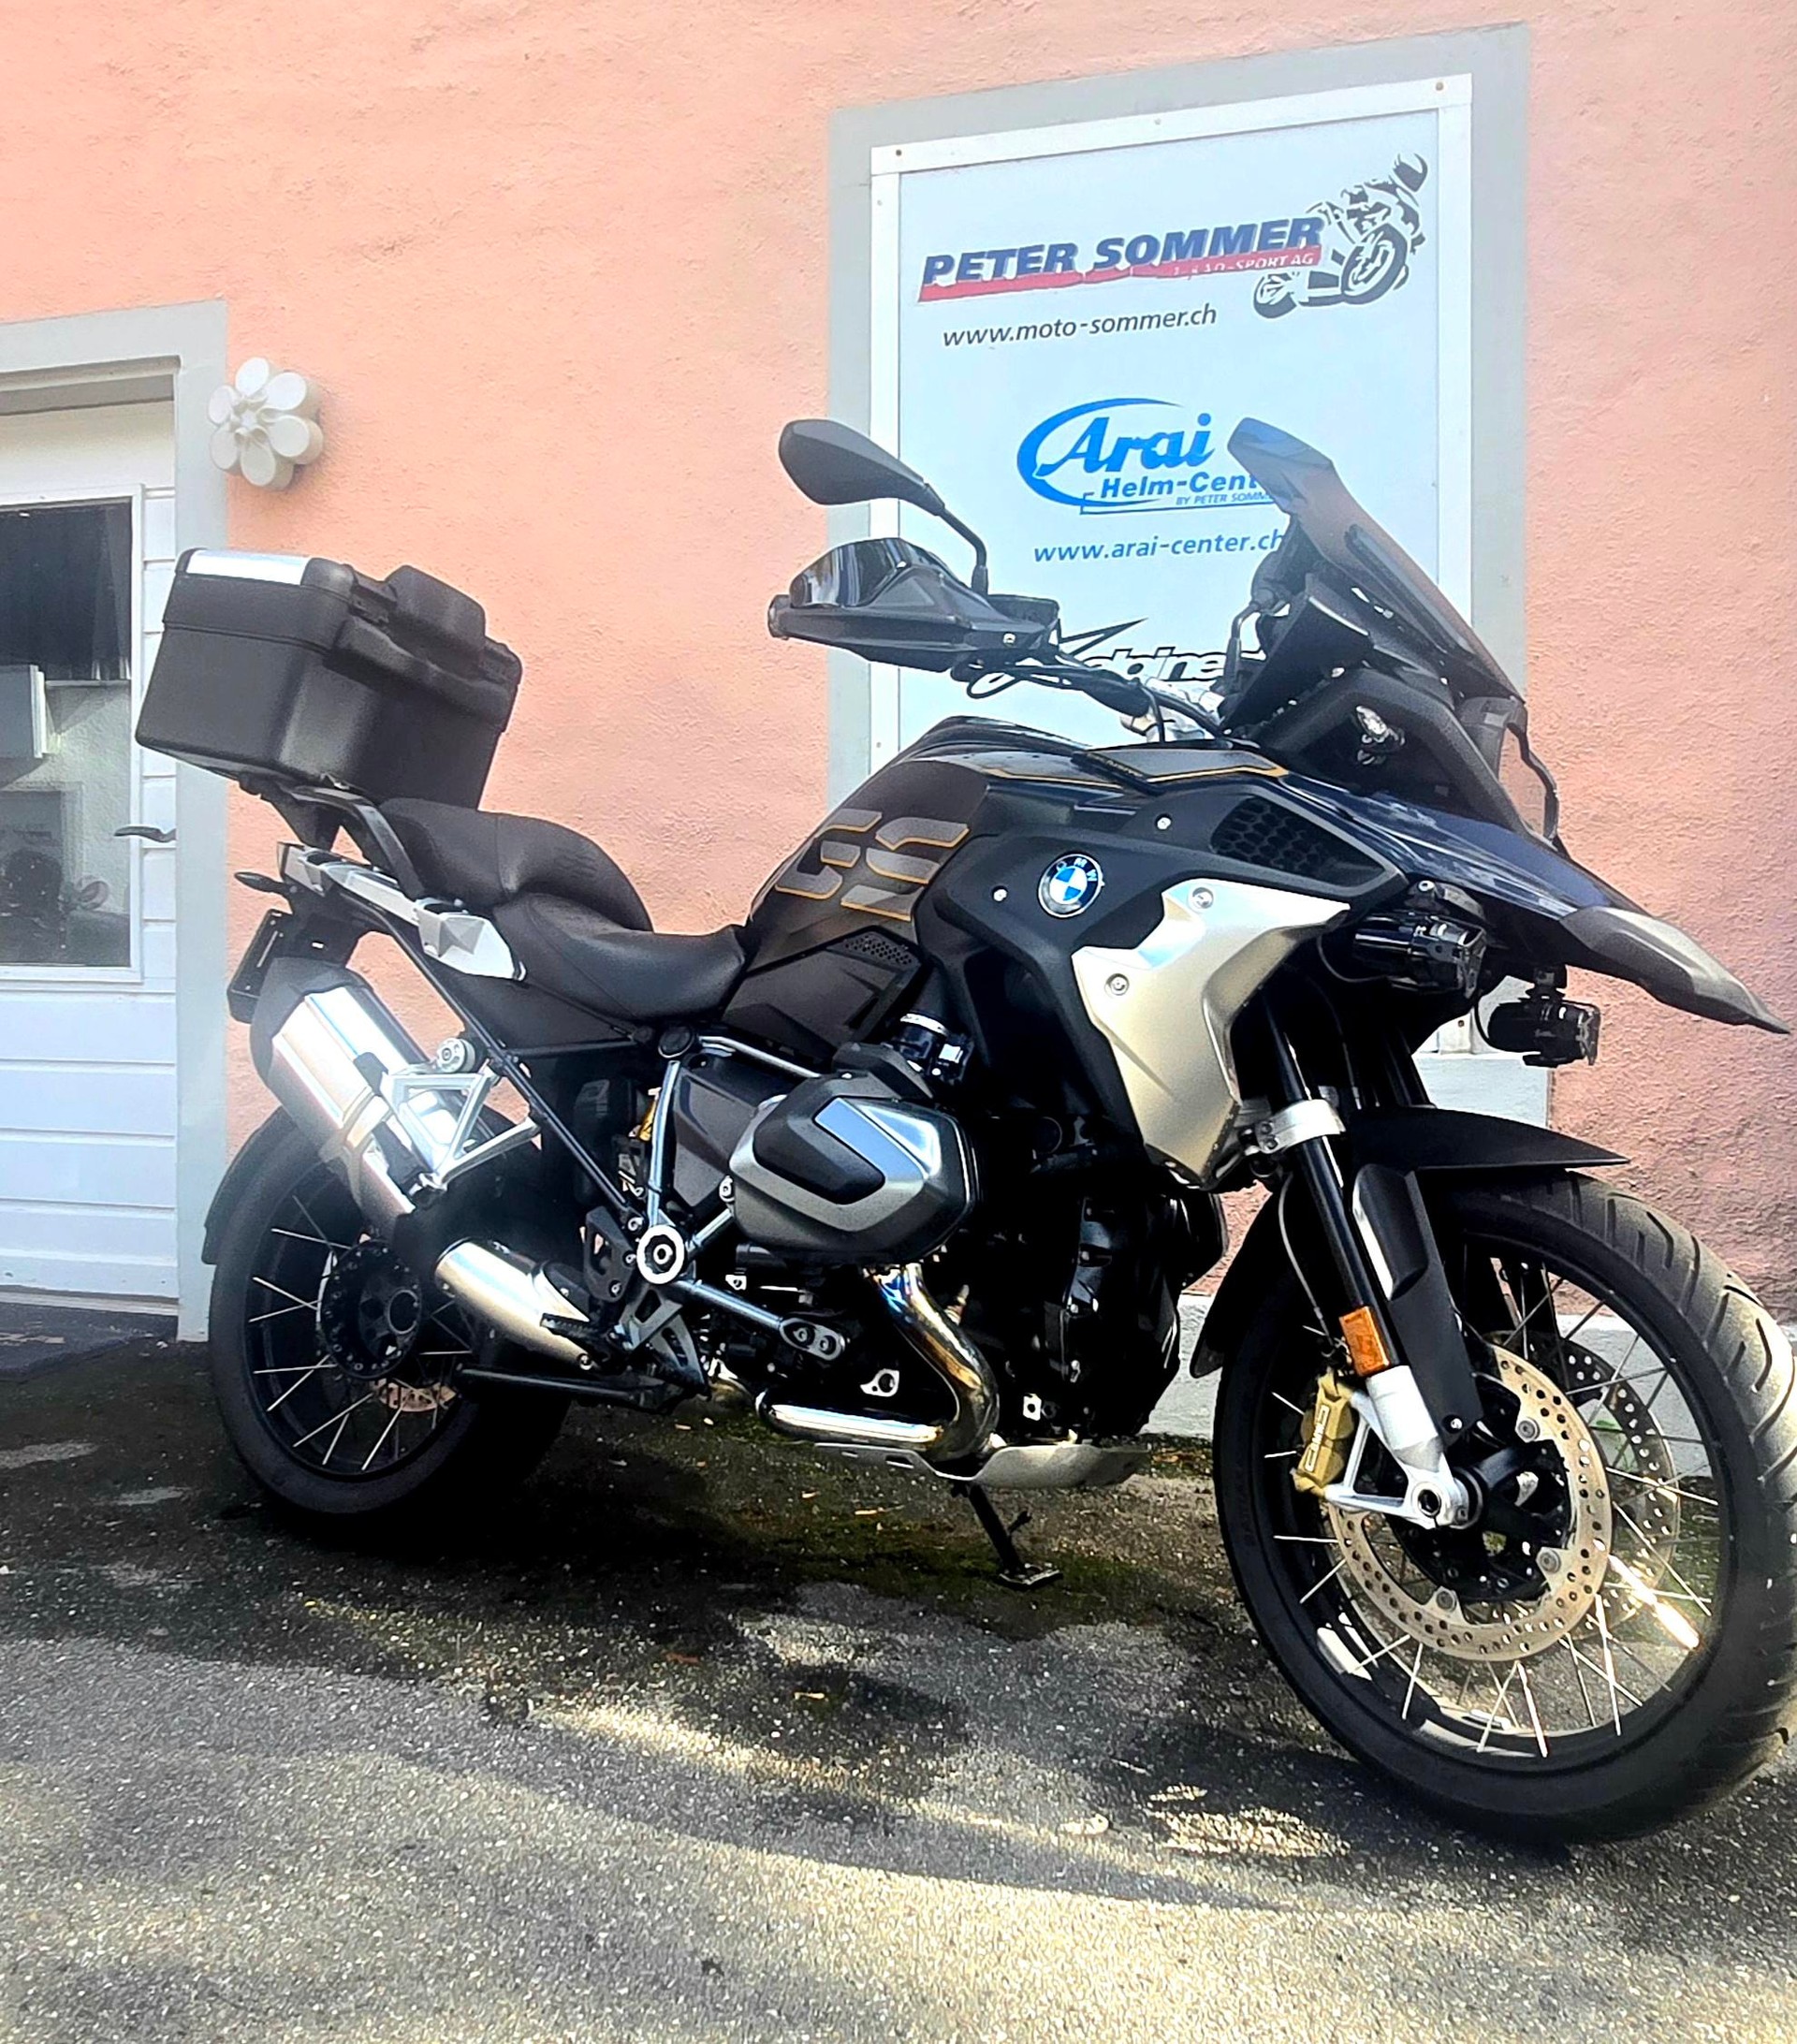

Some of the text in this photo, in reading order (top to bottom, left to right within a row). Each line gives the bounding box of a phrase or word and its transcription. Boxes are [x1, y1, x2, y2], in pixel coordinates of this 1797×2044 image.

[922, 216, 1326, 285] PETER SOMMER
[1290, 252, 1315, 266] AG
[942, 302, 1218, 347] www.moto-sommer.ch
[1033, 412, 1217, 477] Arai
[1100, 471, 1259, 499] Helm-Cent
[1176, 496, 1191, 505] BY
[1193, 494, 1228, 504] PETER
[1033, 528, 1283, 562] www.arai-center.ch
[1056, 856, 1099, 883] BMW
